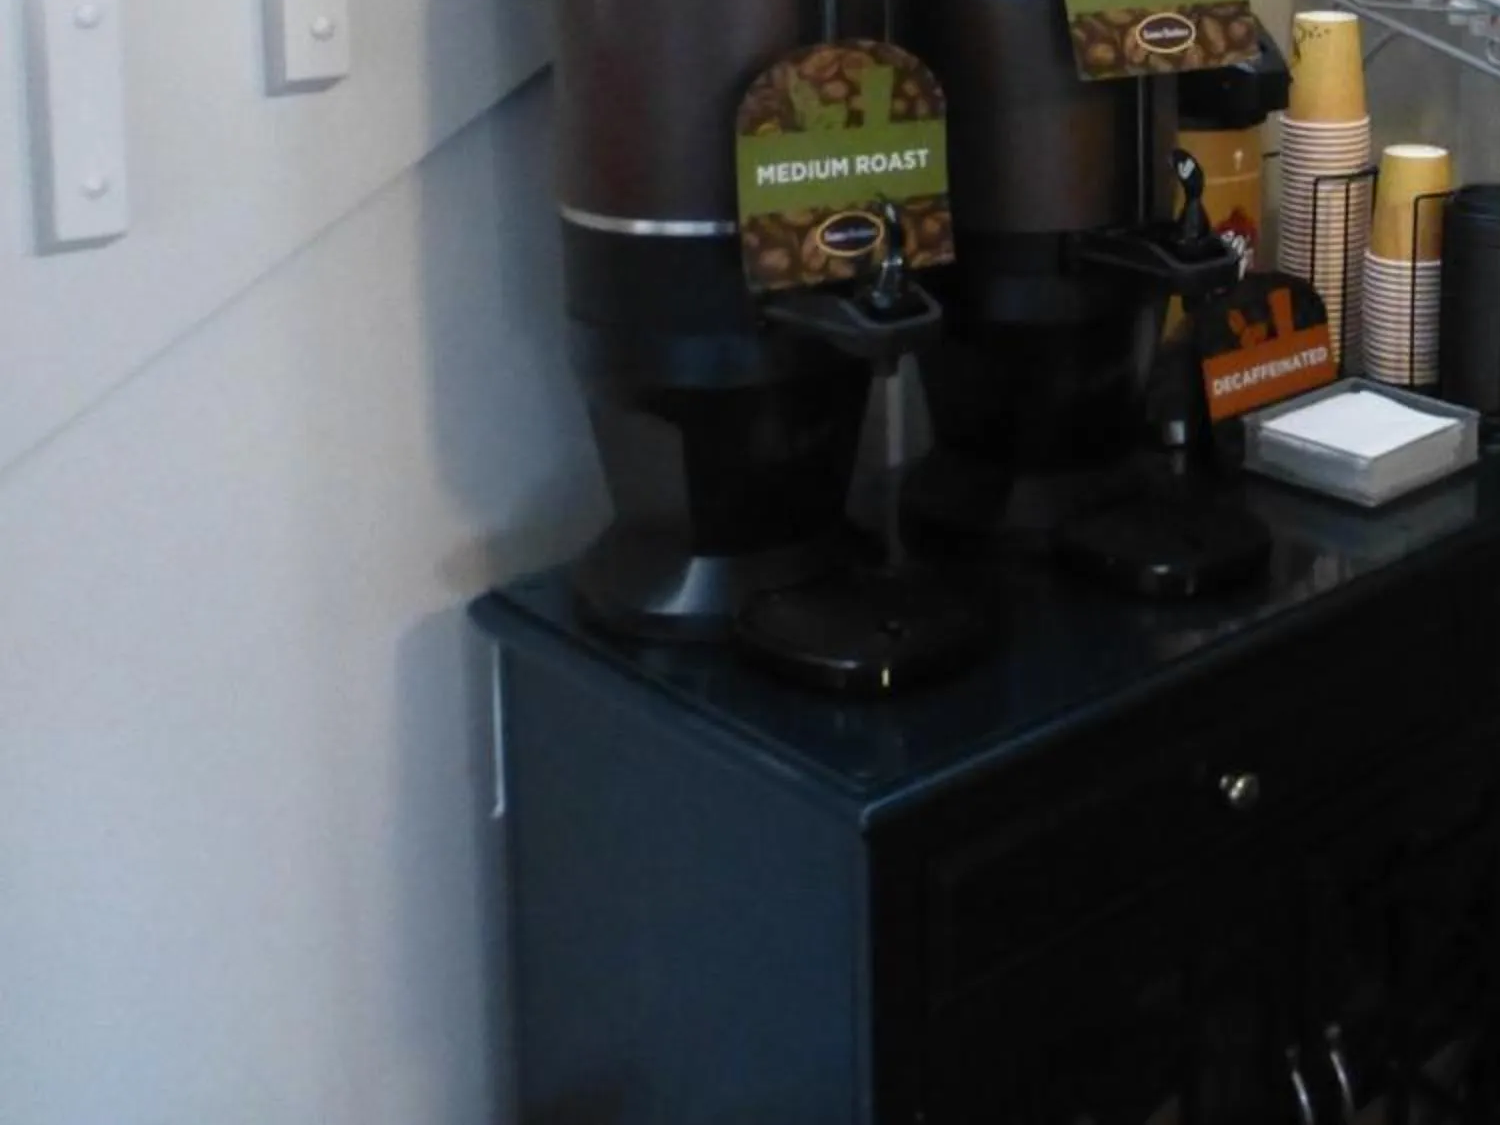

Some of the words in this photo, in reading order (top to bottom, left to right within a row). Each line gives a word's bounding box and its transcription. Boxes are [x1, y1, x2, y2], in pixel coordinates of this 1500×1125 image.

[757, 157, 849, 187] MEDIUM
[856, 148, 929, 175] ROAST
[1212, 346, 1328, 396] DECAFFEINATED
